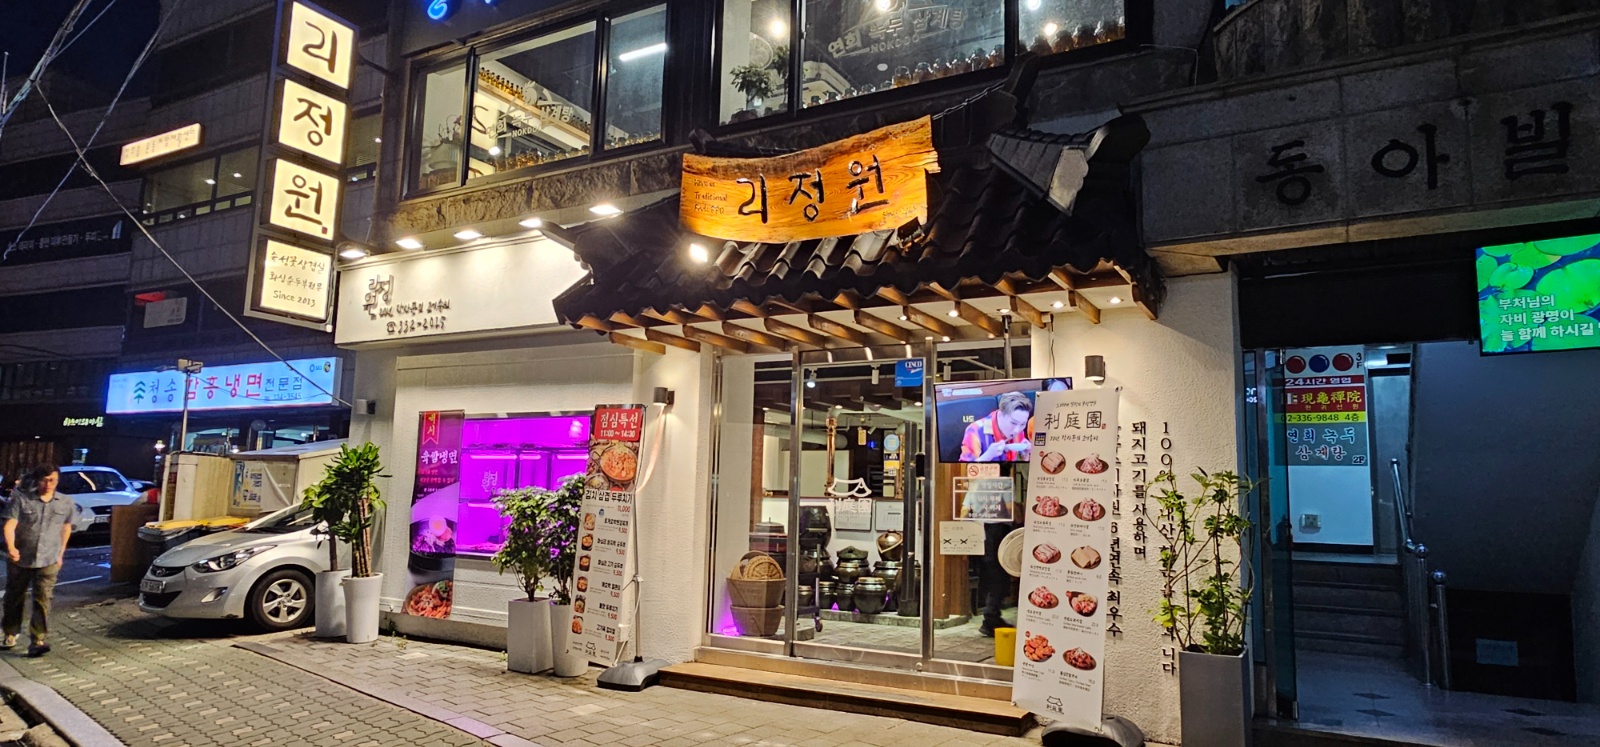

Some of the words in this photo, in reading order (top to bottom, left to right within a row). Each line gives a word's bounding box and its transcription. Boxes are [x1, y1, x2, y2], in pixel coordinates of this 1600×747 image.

[828, 28, 861, 58] 연희
[284, 21, 338, 226] 리정원
[512, 126, 541, 137] NOKDO
[1255, 101, 1574, 206] 동아빌
[736, 154, 890, 224] 리정원
[273, 290, 295, 301] Since
[297, 296, 316, 307] 2013
[1499, 294, 1555, 310] 부처님의
[1500, 312, 1527, 325] 자비
[1532, 308, 1574, 324] 광명이
[1501, 330, 1514, 341] 늘
[1519, 326, 1546, 340] 함께
[1550, 322, 1594, 337] 하시길
[150, 378, 178, 403] 청송
[184, 373, 263, 400] 함흥냉면
[264, 376, 303, 392] 전문점
[1285, 378, 1327, 386] 24시간
[600, 411, 639, 429] 점심특선
[1044, 410, 1102, 430] 利庭園
[1281, 413, 1339, 421] 02-336-9848
[1344, 413, 1359, 421] 4층
[621, 430, 636, 438] 14:30
[1287, 428, 1315, 444] 연희
[1323, 427, 1355, 444] 녹두
[1131, 421, 1148, 499] 돼지고기를
[1296, 445, 1347, 461] 삼계탕
[1352, 456, 1366, 464] 2F
[585, 490, 598, 500] 김치
[599, 491, 610, 502] 삼겹
[611, 493, 632, 504] 두루치기
[1132, 503, 1148, 559] 사용하며
[1106, 590, 1122, 638] 최우수
